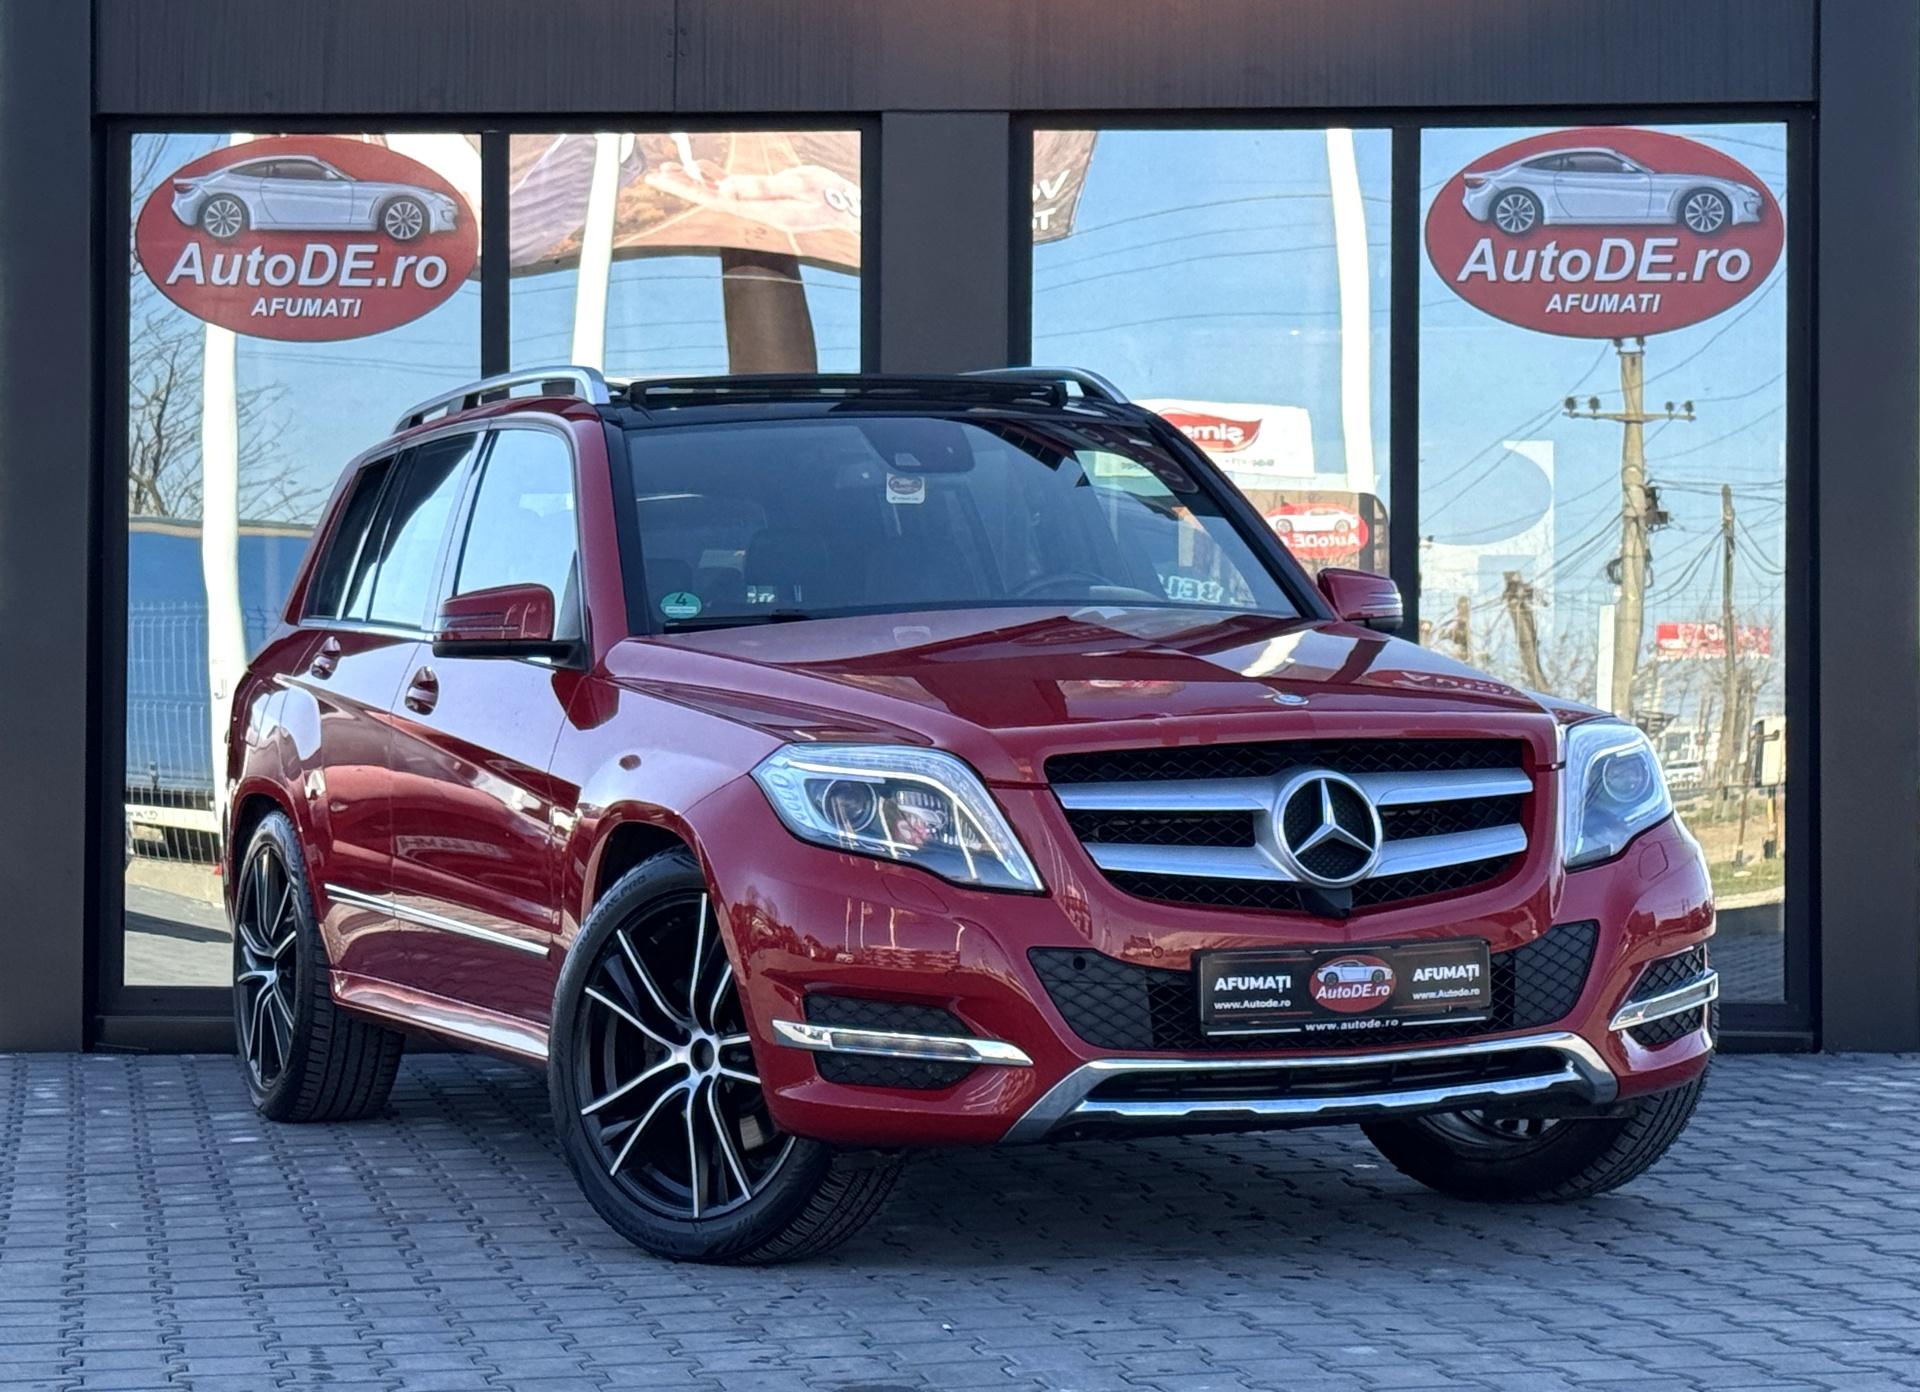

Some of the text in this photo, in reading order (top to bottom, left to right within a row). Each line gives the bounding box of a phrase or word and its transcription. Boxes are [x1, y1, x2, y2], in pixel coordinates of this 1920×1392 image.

[167, 242, 449, 290] AutoDE.ro
[1457, 236, 1753, 284] AutoDE.ro
[251, 297, 363, 317] AFUMATI
[1545, 293, 1662, 314] AFUMATI
[674, 592, 689, 607] 4
[1315, 983, 1391, 1001] AutoDE.ro
[1412, 987, 1481, 1001] www.Autode.ro
[1213, 998, 1291, 1010] www.Autode.ro
[1305, 1017, 1399, 1032] www.autode.ro
